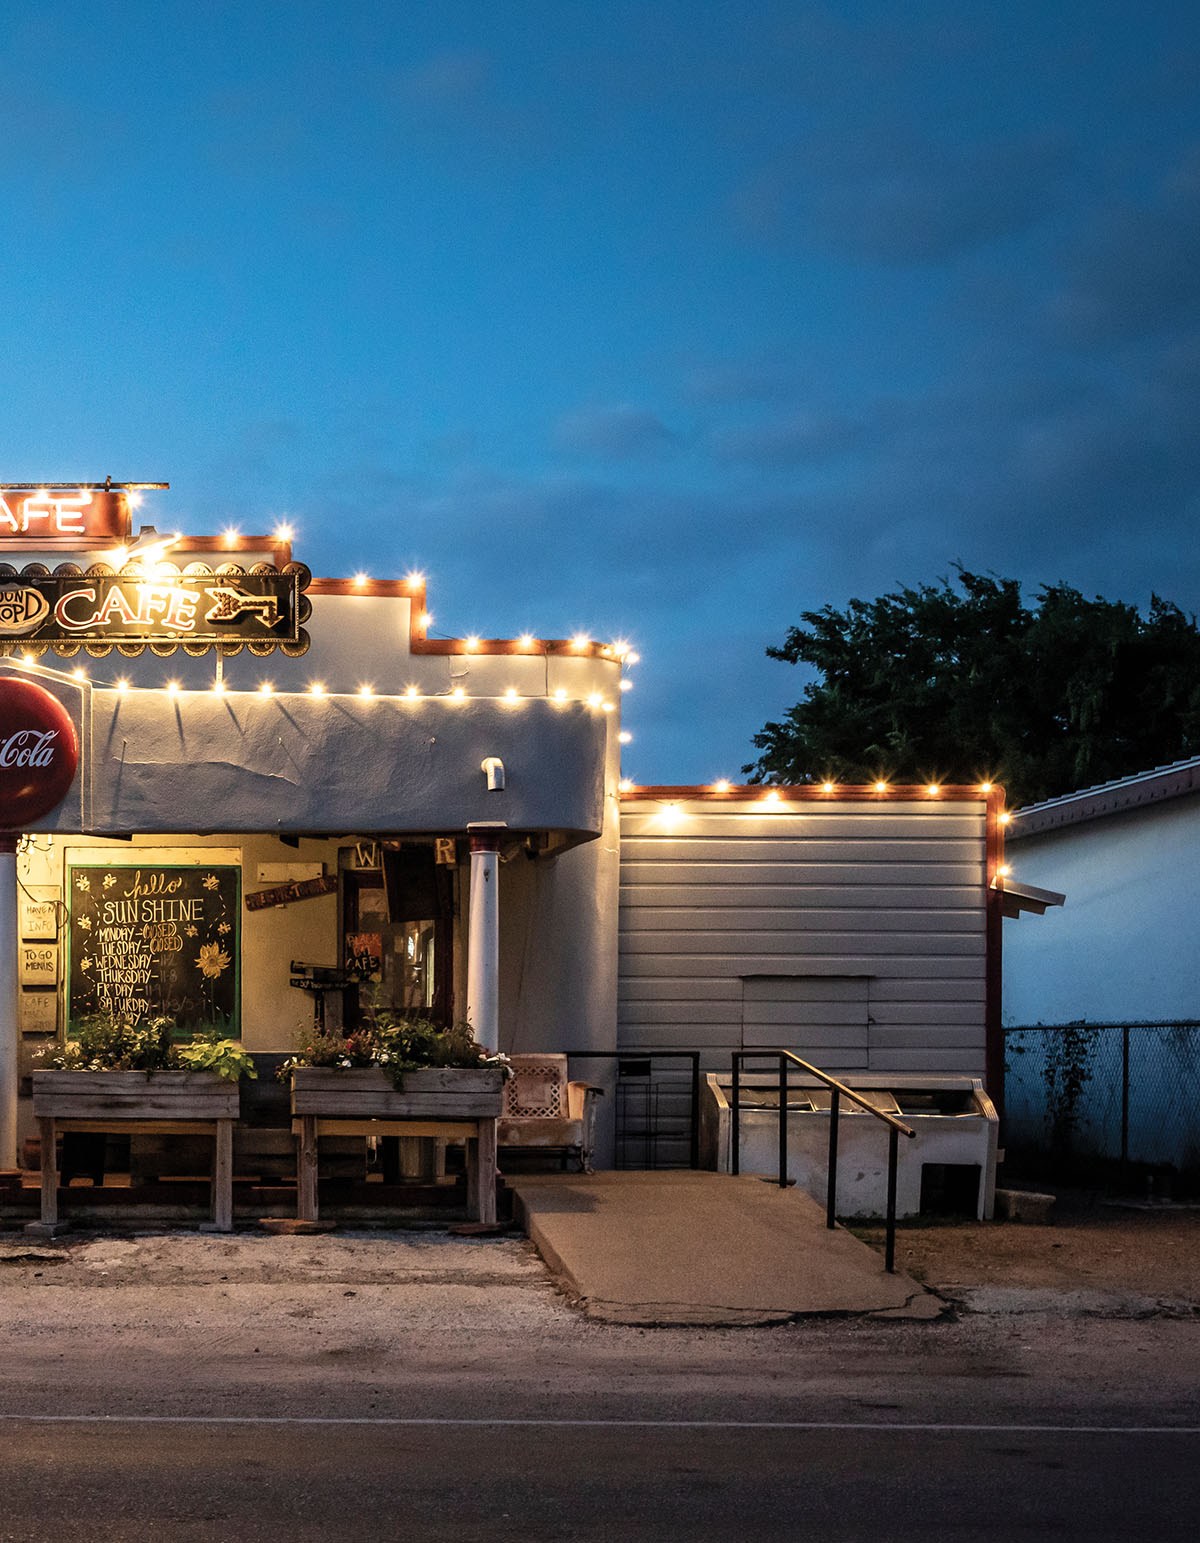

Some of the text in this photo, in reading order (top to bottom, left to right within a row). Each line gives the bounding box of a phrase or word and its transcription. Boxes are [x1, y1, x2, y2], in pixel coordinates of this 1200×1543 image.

[54, 585, 200, 631] CAFE
[124, 870, 182, 899] hello
[26, 905, 55, 916] HAVEN
[102, 899, 204, 924] SUNSHINE
[28, 921, 53, 932] INFO
[99, 927, 135, 942] MONDAY
[24, 950, 53, 960] TO GO
[97, 940, 142, 955] TUESDAY
[25, 962, 54, 973] MENUS
[95, 954, 152, 970] WEDNESDAY
[96, 969, 152, 984] THURSDAY
